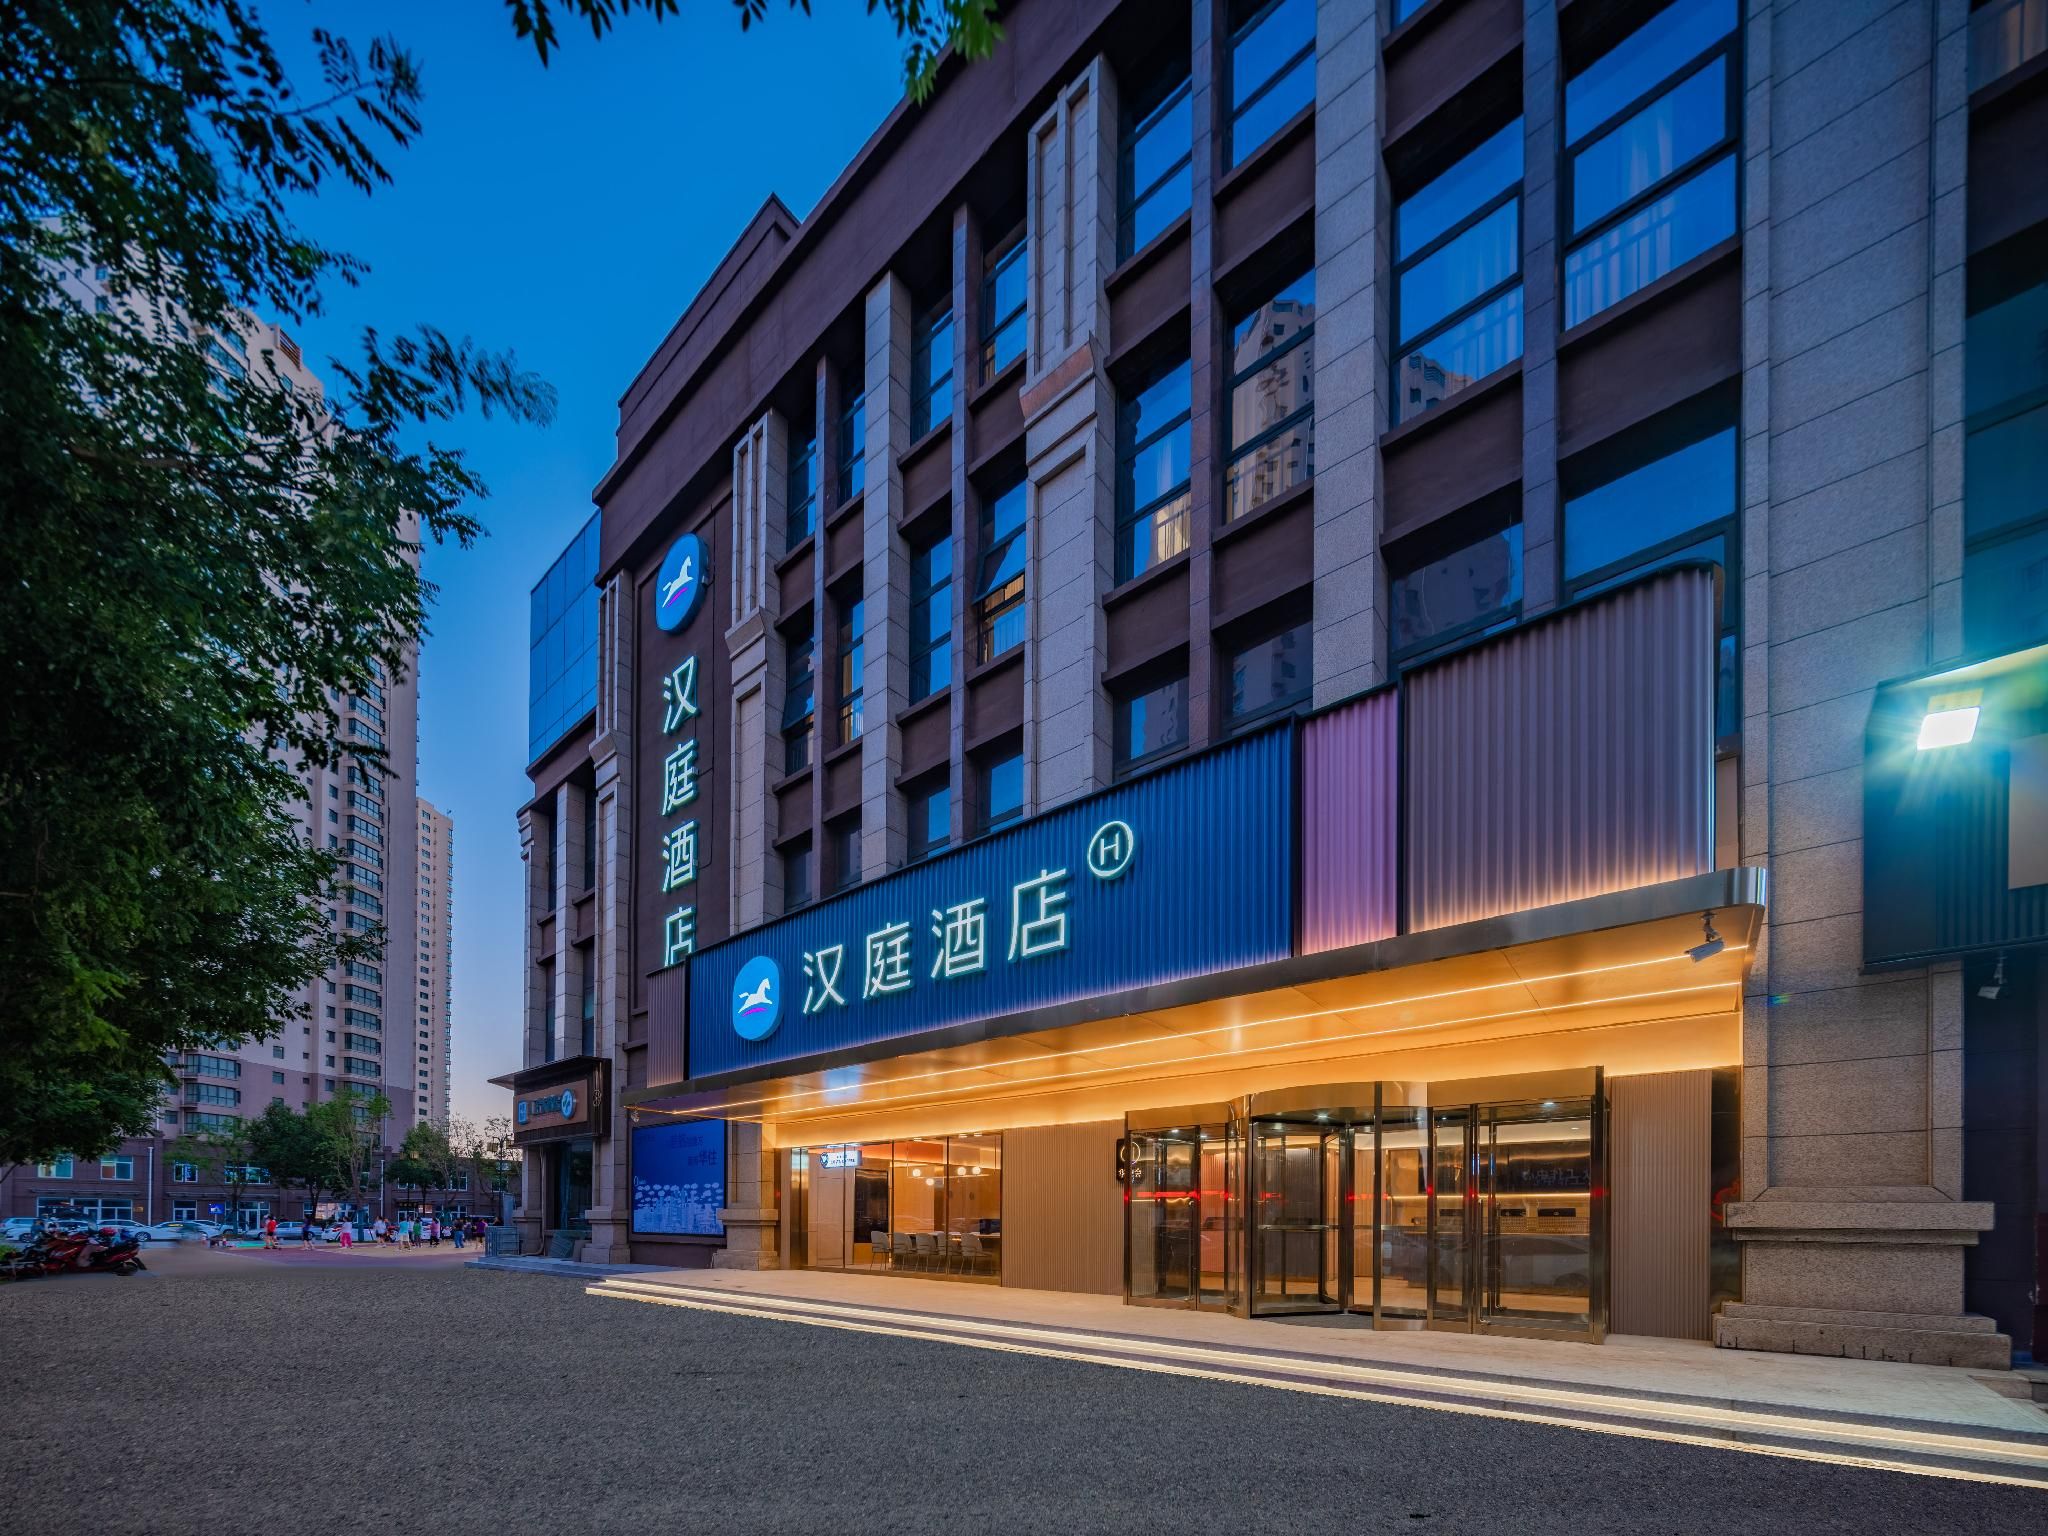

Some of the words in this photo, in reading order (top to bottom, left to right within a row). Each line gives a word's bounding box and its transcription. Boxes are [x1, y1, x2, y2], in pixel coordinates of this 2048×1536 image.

[662, 656, 697, 968] 汉庭酒店
[802, 868, 1067, 1015] 汉庭酒店
